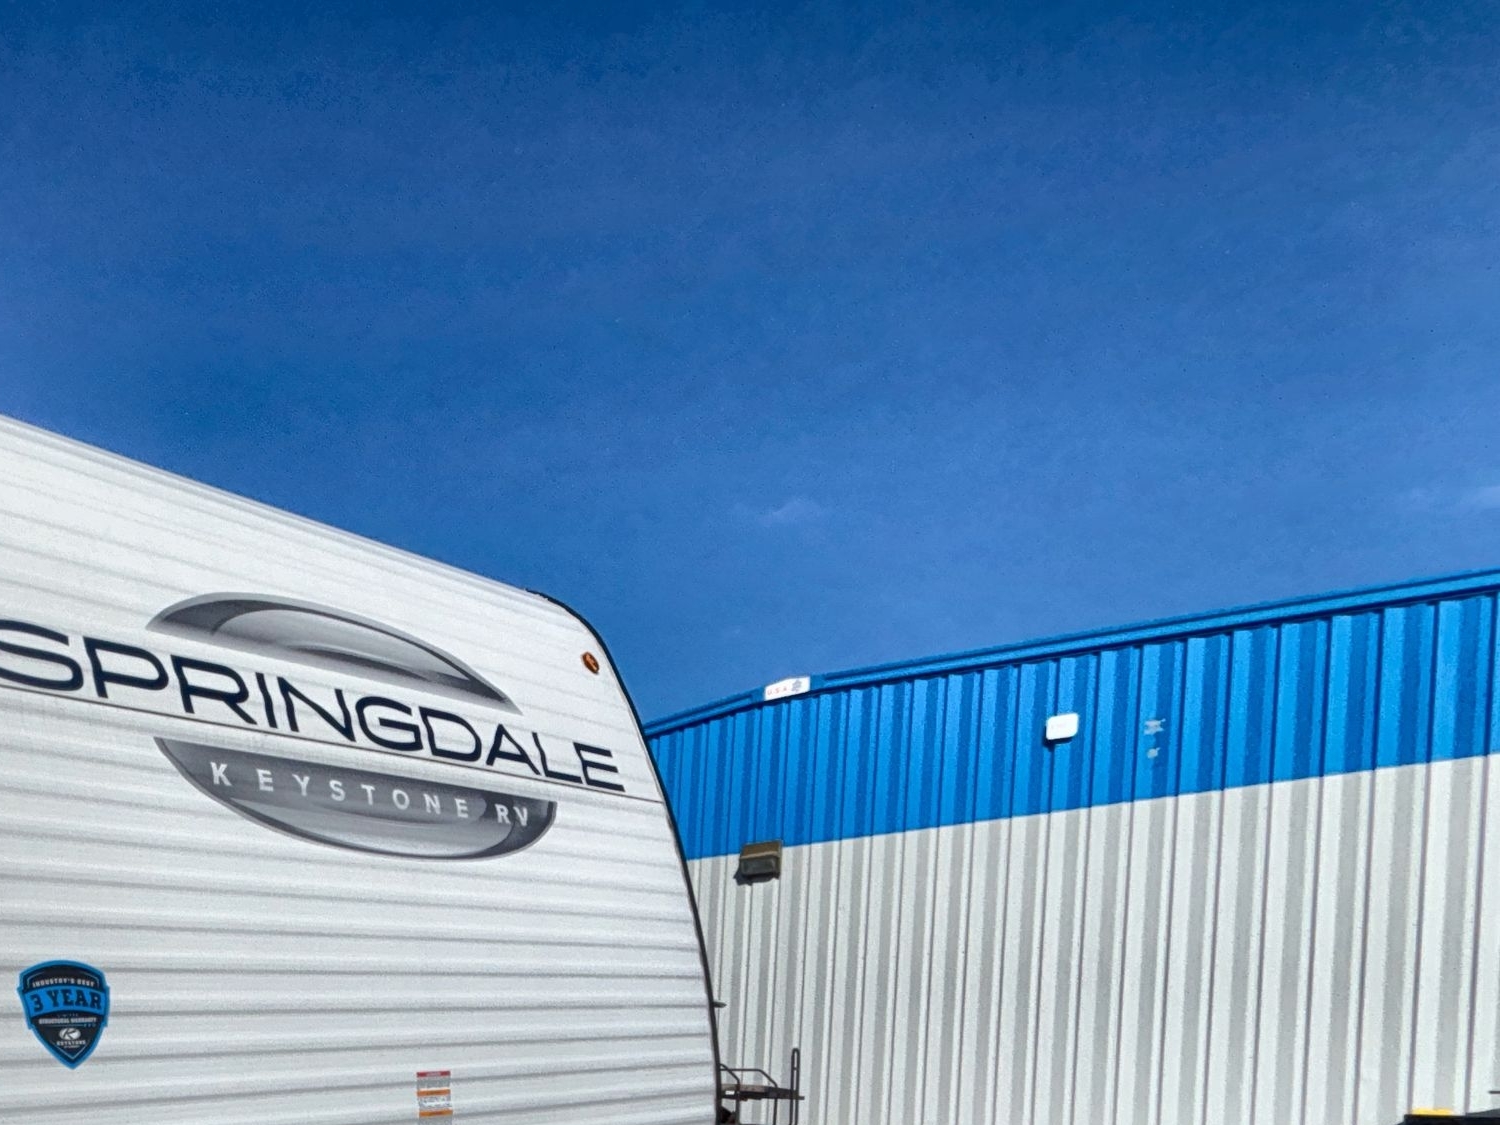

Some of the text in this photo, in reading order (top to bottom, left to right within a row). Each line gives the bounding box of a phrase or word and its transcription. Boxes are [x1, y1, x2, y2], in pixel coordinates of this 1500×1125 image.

[210, 761, 529, 827] KEYSTONE RV
[30, 989, 102, 1012] 3 YEAR
